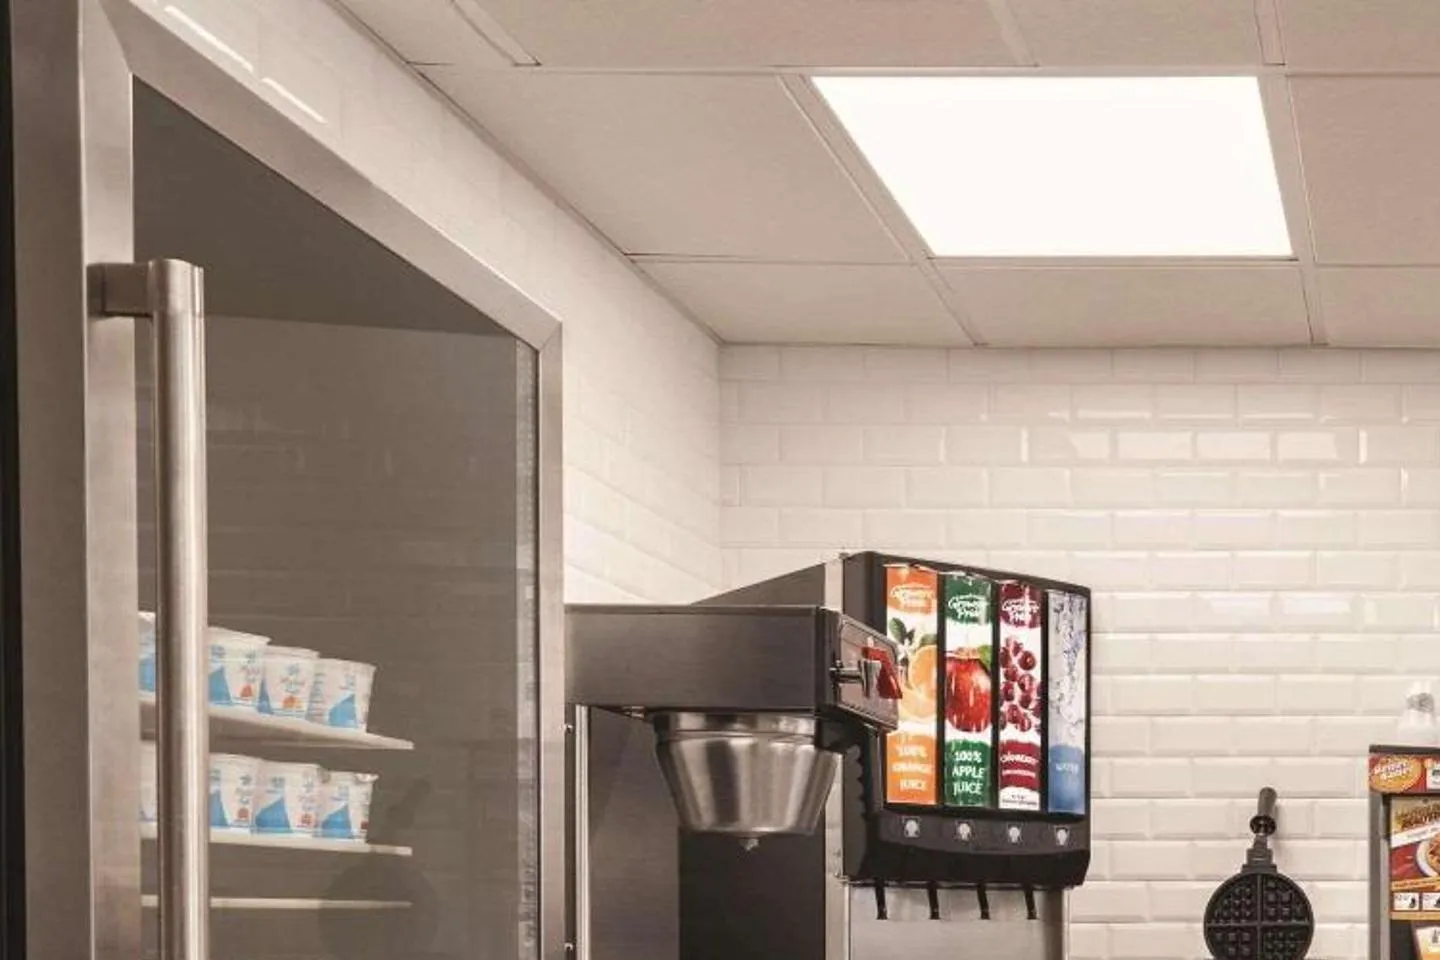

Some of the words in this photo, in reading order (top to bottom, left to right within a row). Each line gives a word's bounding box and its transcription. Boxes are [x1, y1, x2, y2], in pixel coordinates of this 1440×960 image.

[954, 750, 983, 763] 100%
[952, 765, 985, 780] APPLE
[952, 781, 984, 797] JUICE
